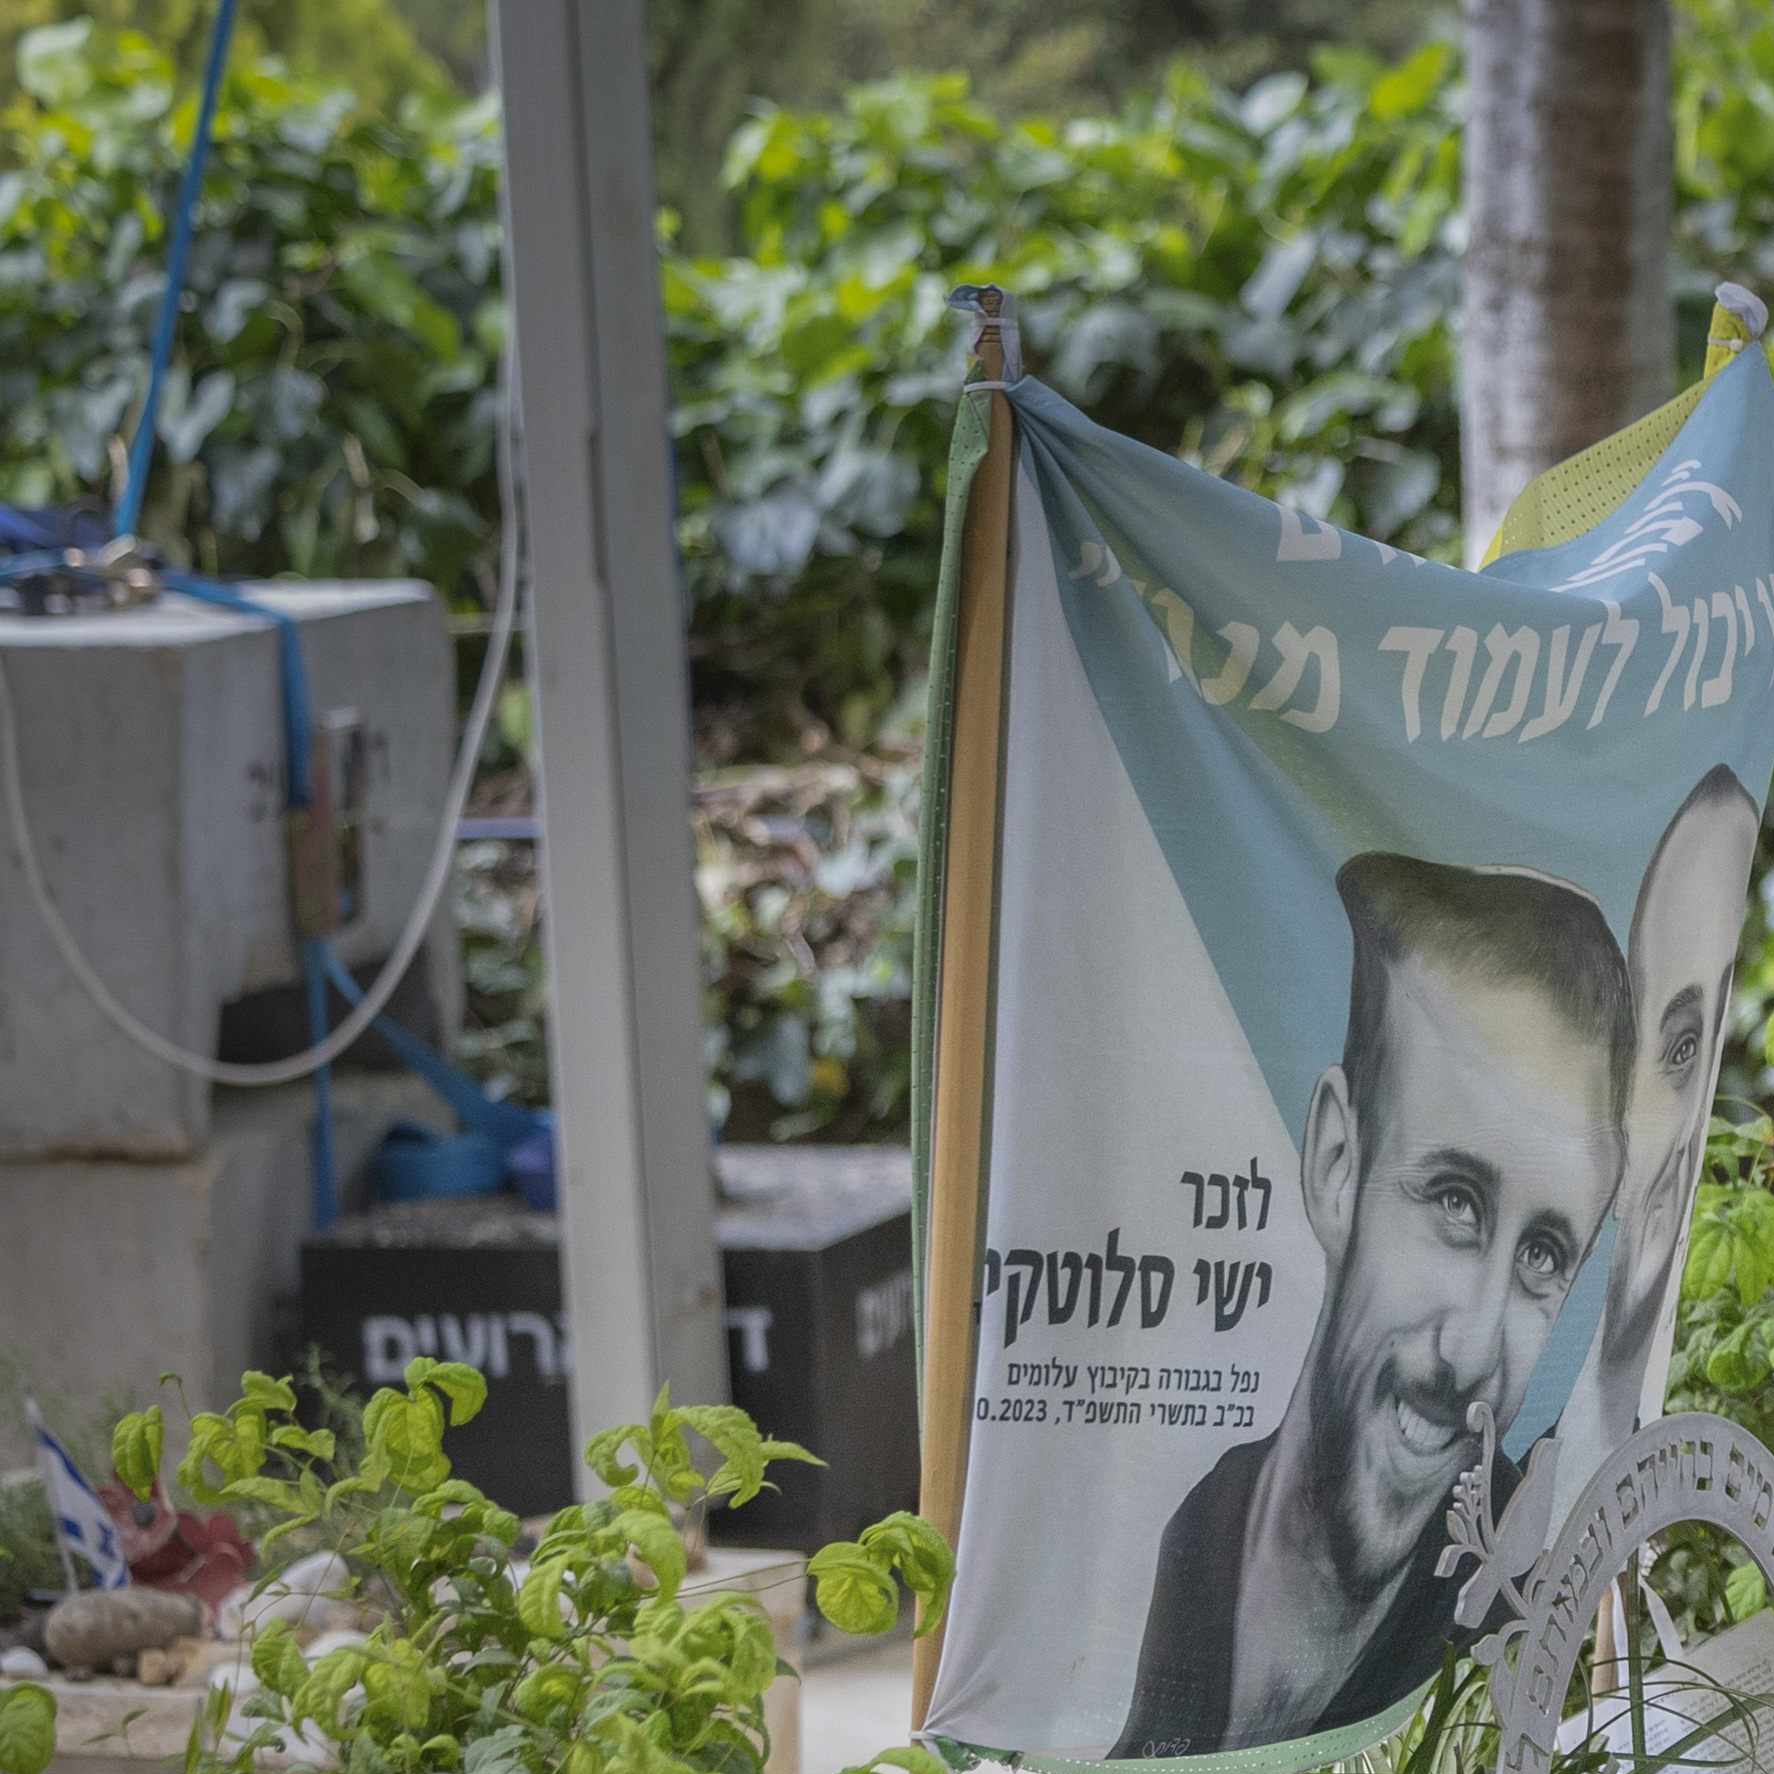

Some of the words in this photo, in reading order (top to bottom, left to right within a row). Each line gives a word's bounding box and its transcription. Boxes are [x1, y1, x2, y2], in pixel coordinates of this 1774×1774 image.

[1378, 600, 1641, 745] לעמוד
[1643, 571, 1755, 719] יכול
[1180, 1156, 1273, 1232] לזכר
[985, 1227, 1175, 1350] סלוטקי
[1193, 1258, 1273, 1333] ישי
[361, 1308, 574, 1383] רועים
[1007, 1355, 1079, 1389] עלומים
[1087, 1365, 1151, 1396] בקיבוץ
[1158, 1366, 1223, 1393] בגבורה
[1231, 1362, 1261, 1394] נפל
[1150, 1403, 1207, 1427] בתשרי
